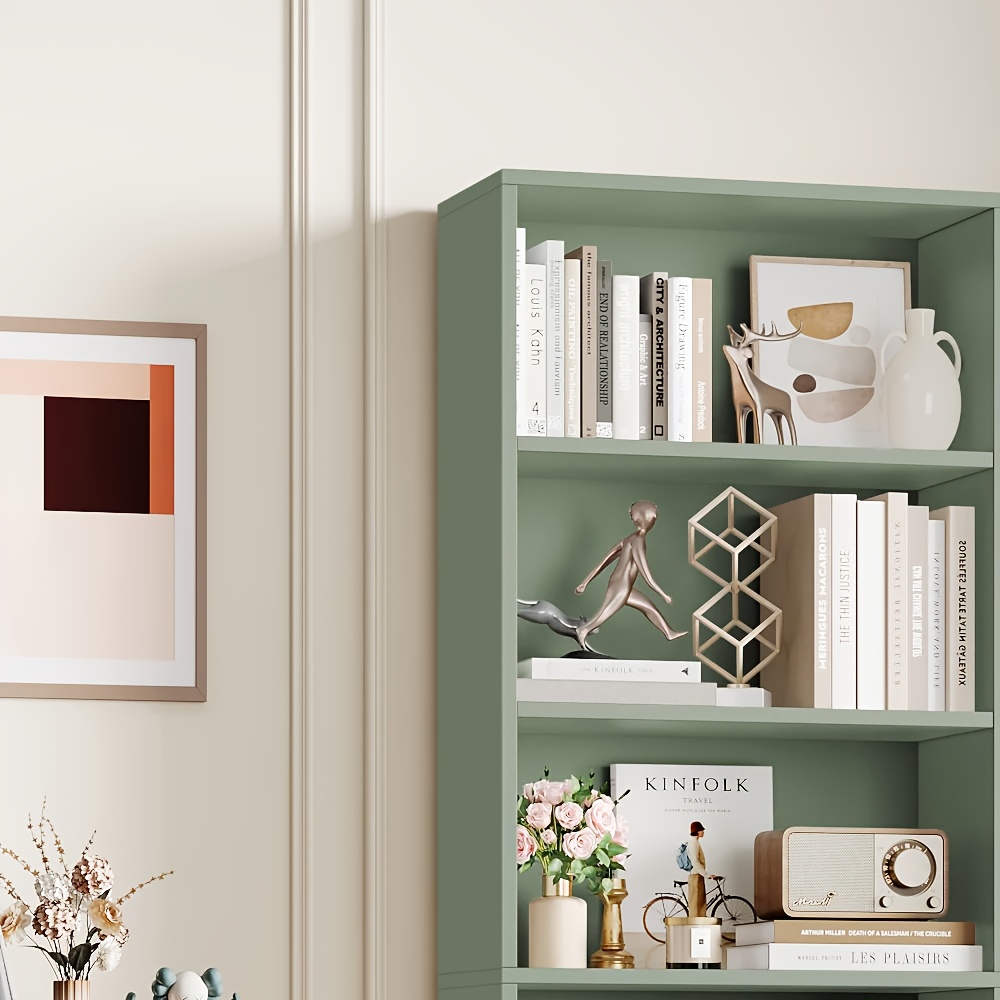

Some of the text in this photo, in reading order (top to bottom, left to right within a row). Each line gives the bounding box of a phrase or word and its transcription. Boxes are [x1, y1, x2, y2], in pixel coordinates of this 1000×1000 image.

[530, 278, 544, 367] Louis Kahn
[553, 259, 562, 338] Expressionism
[598, 292, 610, 313] END
[598, 314, 610, 328] OF
[675, 284, 688, 320] Figure
[566, 278, 576, 421] OIL PAINTING Techniques
[598, 329, 610, 407] REALATIONSHIP
[618, 322, 632, 392] architecture
[638, 333, 649, 387] Graphic & Art
[655, 277, 664, 409] CITY & ARCHITECTURE
[675, 323, 688, 371] Drawing
[818, 527, 827, 670] MERINGUES MACARONS
[839, 550, 850, 644] THE THIN JUSTICE
[594, 665, 635, 674] KINFOLK
[645, 777, 749, 792] KINFOLK
[851, 952, 951, 965] LES PLAISIRS
